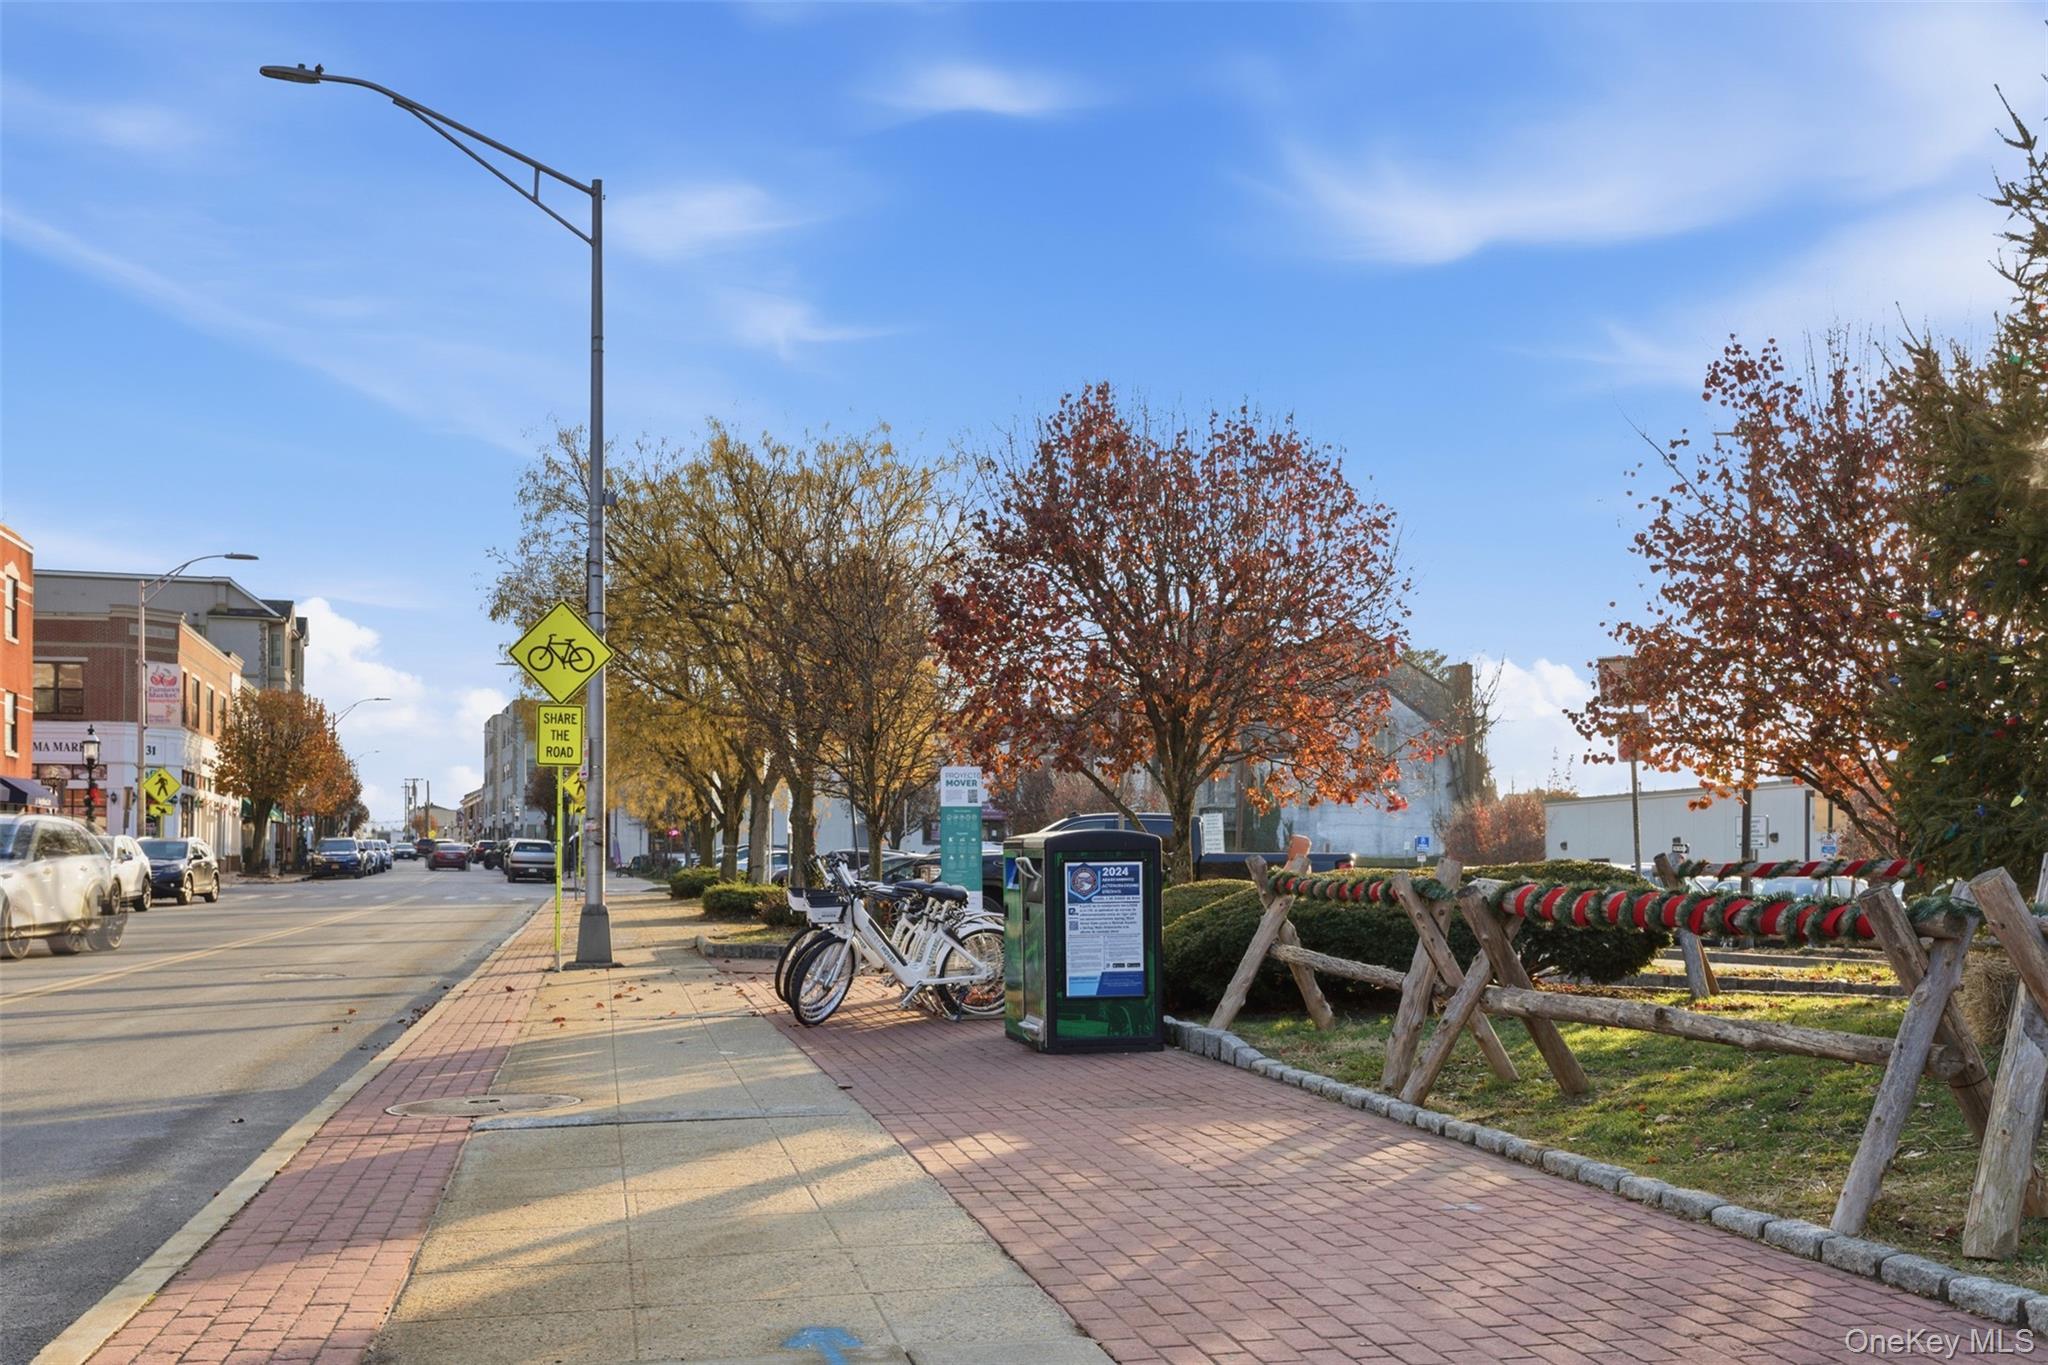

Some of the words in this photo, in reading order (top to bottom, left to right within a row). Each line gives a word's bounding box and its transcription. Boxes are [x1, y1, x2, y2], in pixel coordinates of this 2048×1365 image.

[543, 712, 578, 725] SHARE
[550, 729, 570, 742] THE
[145, 745, 156, 756] 31
[546, 746, 574, 758] ROAD
[945, 779, 978, 787] MOVER
[1102, 867, 1129, 877] 2024
